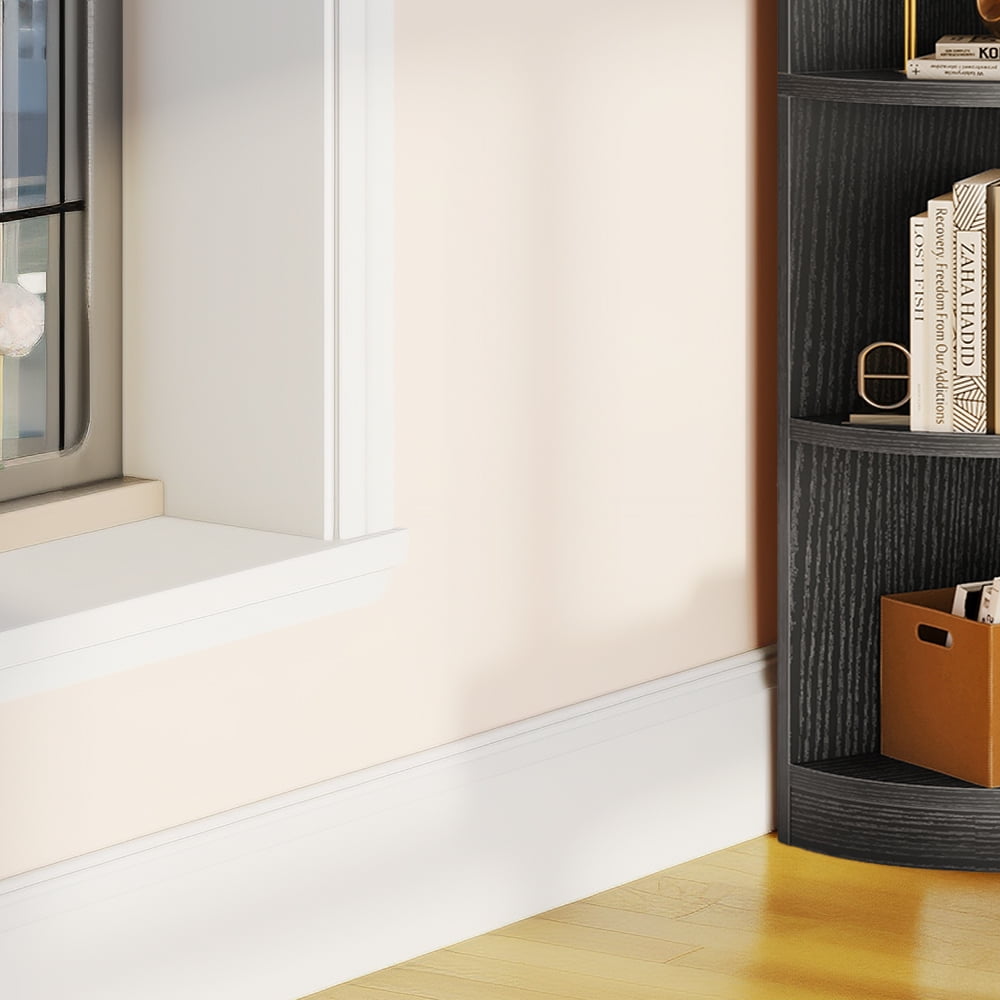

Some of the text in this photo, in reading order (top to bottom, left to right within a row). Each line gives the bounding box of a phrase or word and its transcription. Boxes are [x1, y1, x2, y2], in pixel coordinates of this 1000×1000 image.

[914, 223, 925, 321] LOST FISH
[931, 207, 948, 425] Recovery. Freedom From Our Addictions
[961, 243, 976, 367] ZAHA HADID
